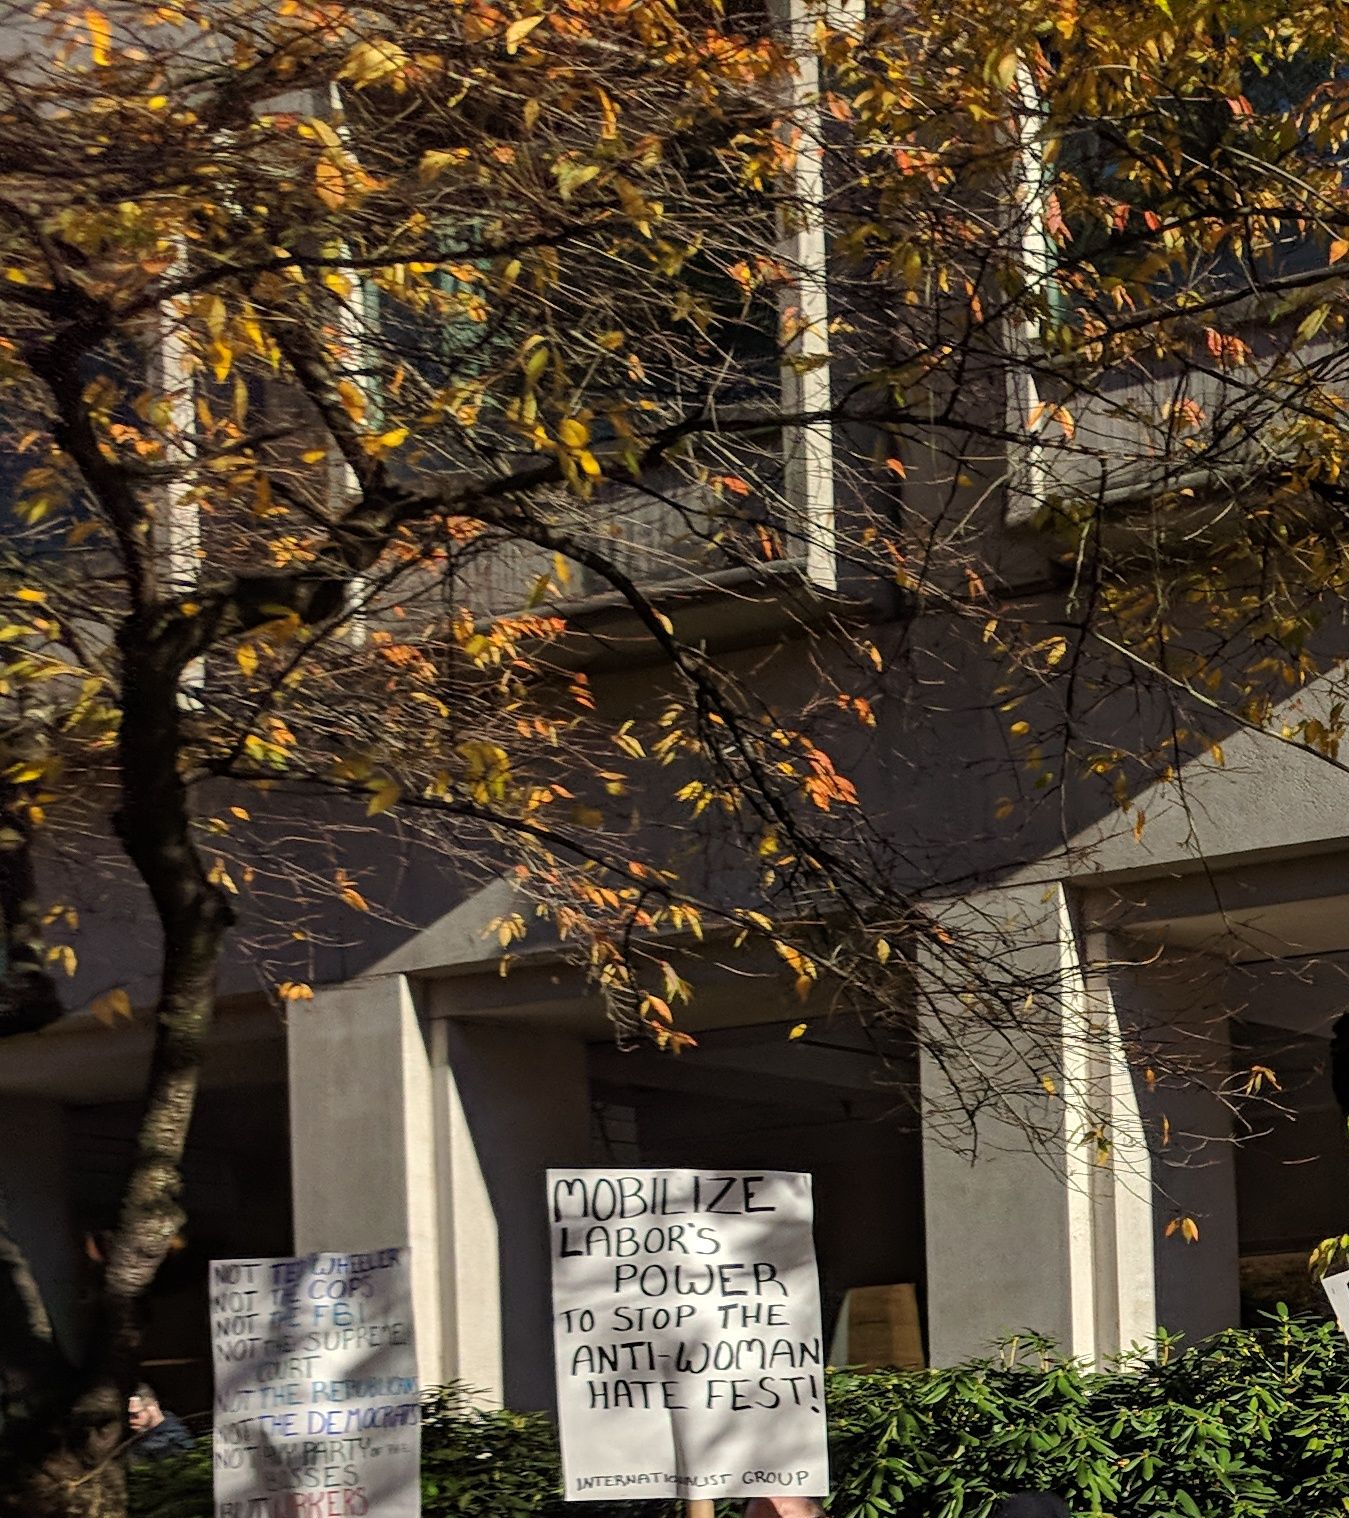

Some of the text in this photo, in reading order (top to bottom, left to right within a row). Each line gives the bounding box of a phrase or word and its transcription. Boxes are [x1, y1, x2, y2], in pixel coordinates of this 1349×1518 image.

[554, 1175, 776, 1223] MOBILIZE
[560, 1222, 721, 1258] LABOR'S
[270, 1284, 301, 1306] TE
[308, 1275, 374, 1300] COPS
[613, 1262, 789, 1298] POWER
[215, 1302, 364, 1336] NOT TE FBI
[560, 1302, 791, 1334] TO STOP THE
[215, 1337, 262, 1362] NOT
[571, 1337, 821, 1376] ANTI-WOMAN
[259, 1382, 305, 1407] THE
[587, 1374, 821, 1414] HATE FEST!
[263, 1464, 360, 1492] BSSES
[741, 1470, 810, 1487] GROUP
